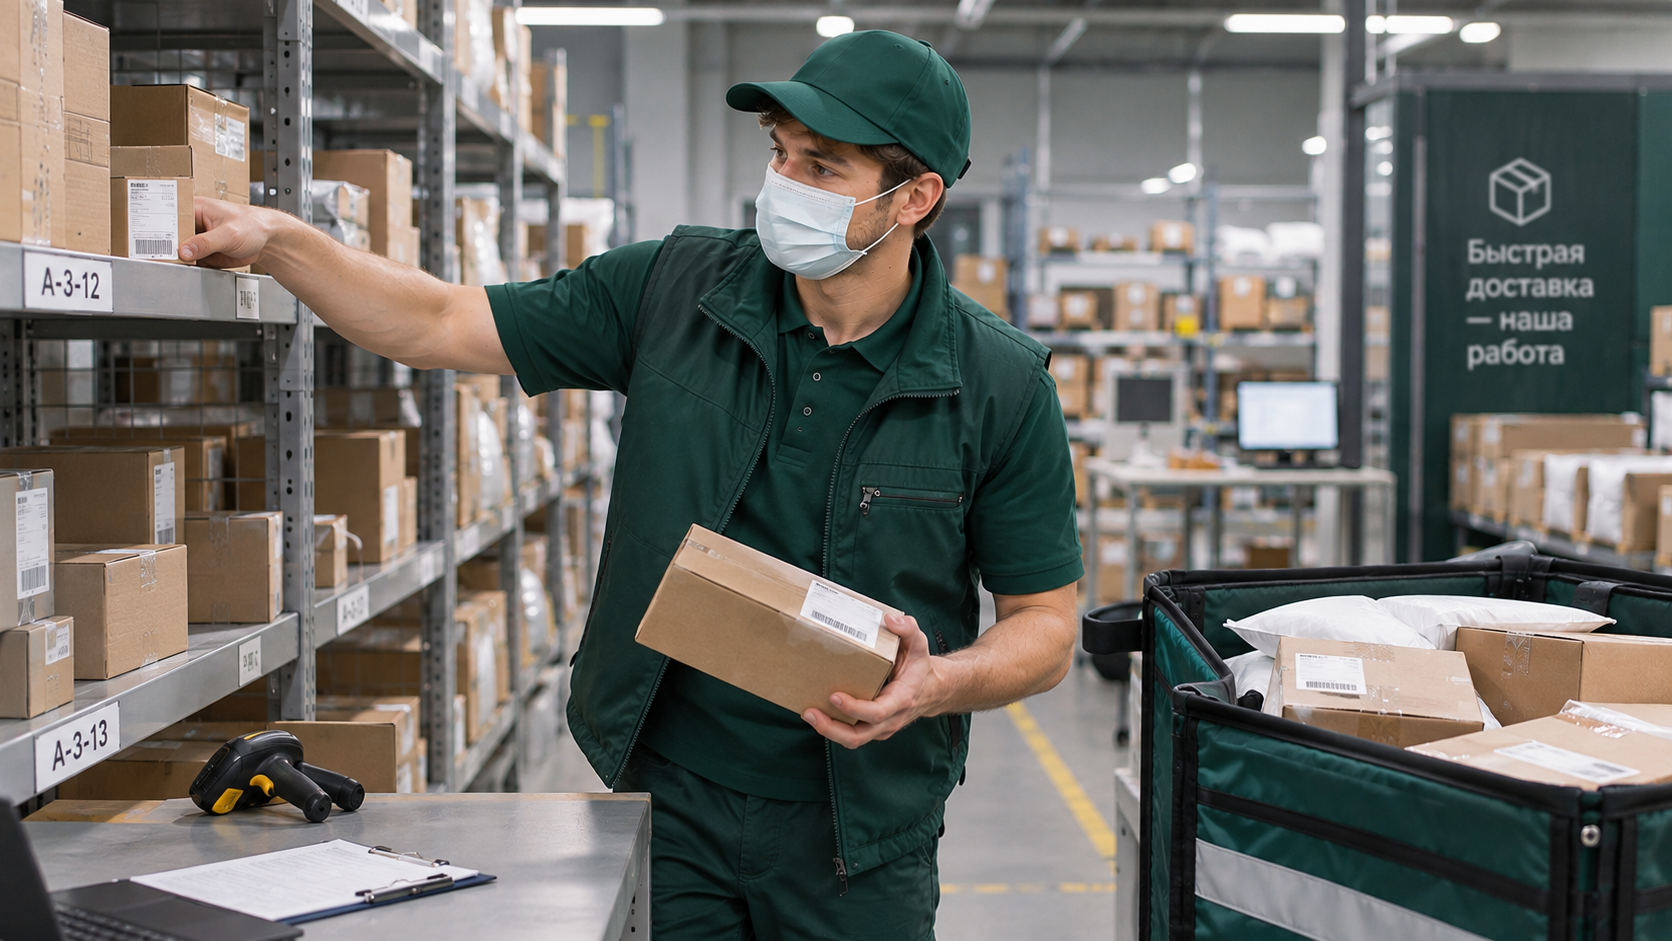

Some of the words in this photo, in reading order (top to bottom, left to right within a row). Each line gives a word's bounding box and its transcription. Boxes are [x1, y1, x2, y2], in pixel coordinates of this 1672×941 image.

[1467, 238, 1585, 269] Быстрая
[41, 267, 100, 299] A-3-12
[1465, 277, 1594, 301] доставка
[1499, 310, 1573, 331] наша
[1467, 338, 1565, 371] работа
[52, 719, 108, 772] A-3-13
